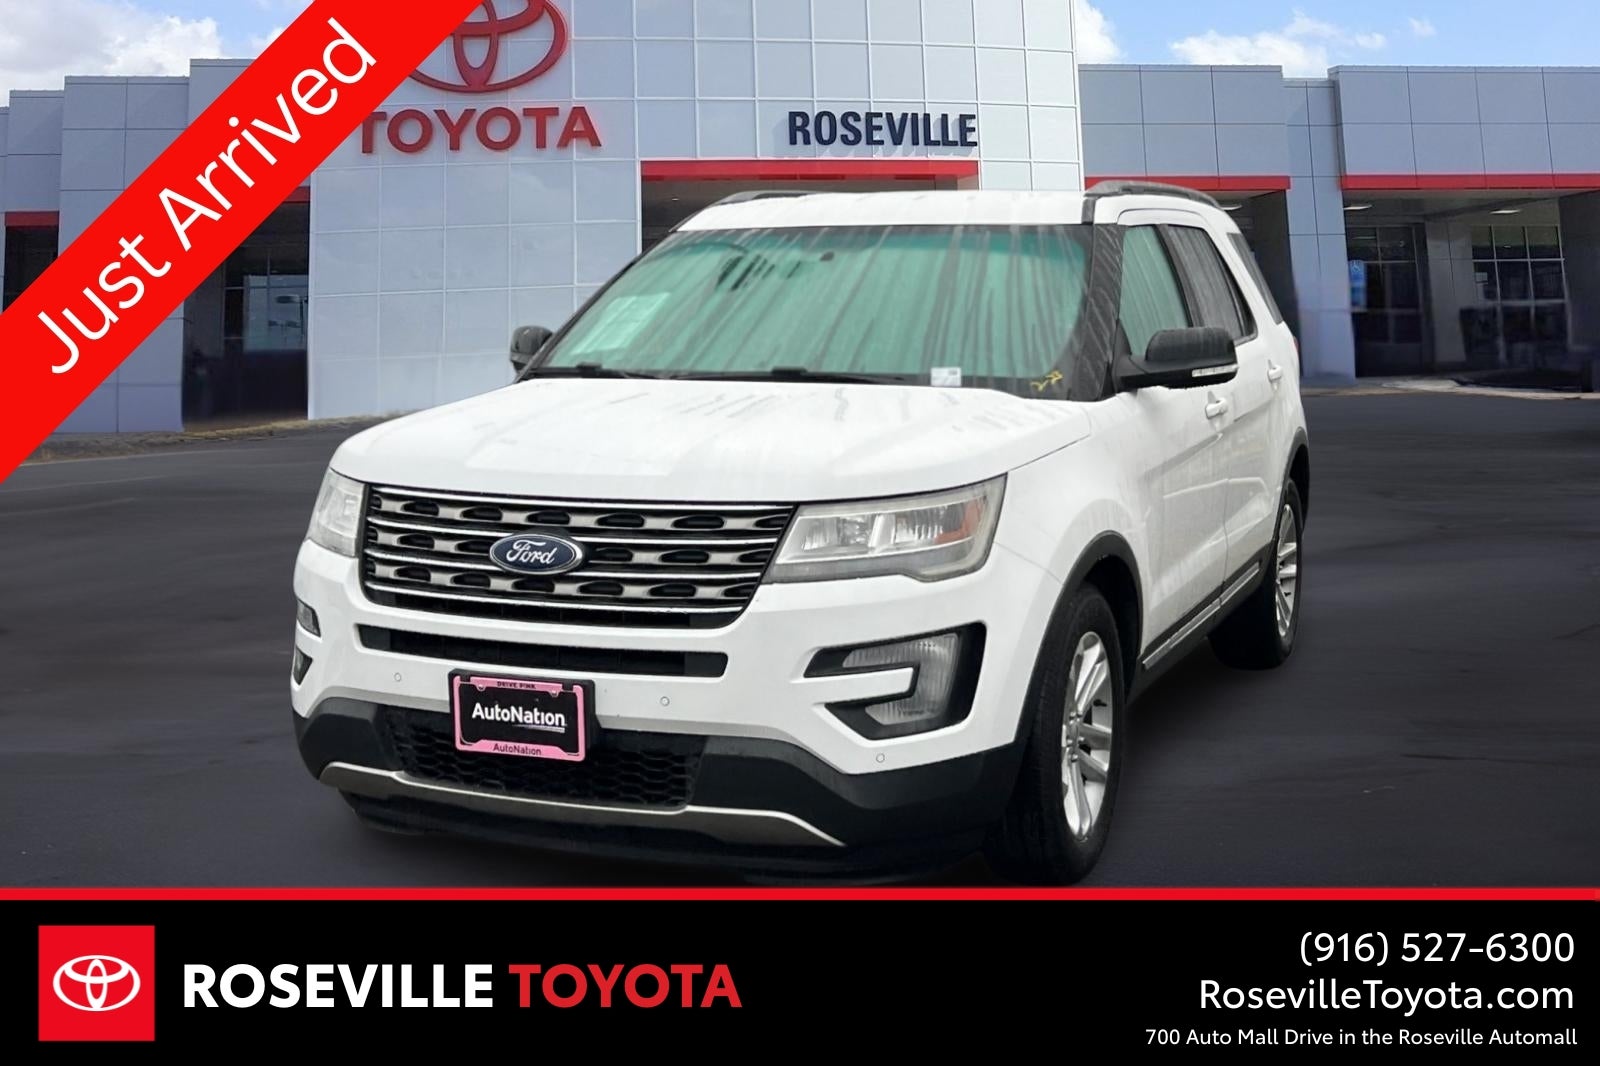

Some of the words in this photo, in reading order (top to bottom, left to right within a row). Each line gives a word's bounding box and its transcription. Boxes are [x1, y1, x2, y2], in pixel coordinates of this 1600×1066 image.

[361, 106, 602, 154] TOYOTA
[788, 110, 978, 147] ROSEVILLE
[506, 539, 558, 565] Ford
[471, 702, 566, 727] AutoNation
[493, 743, 542, 756] AutoNation
